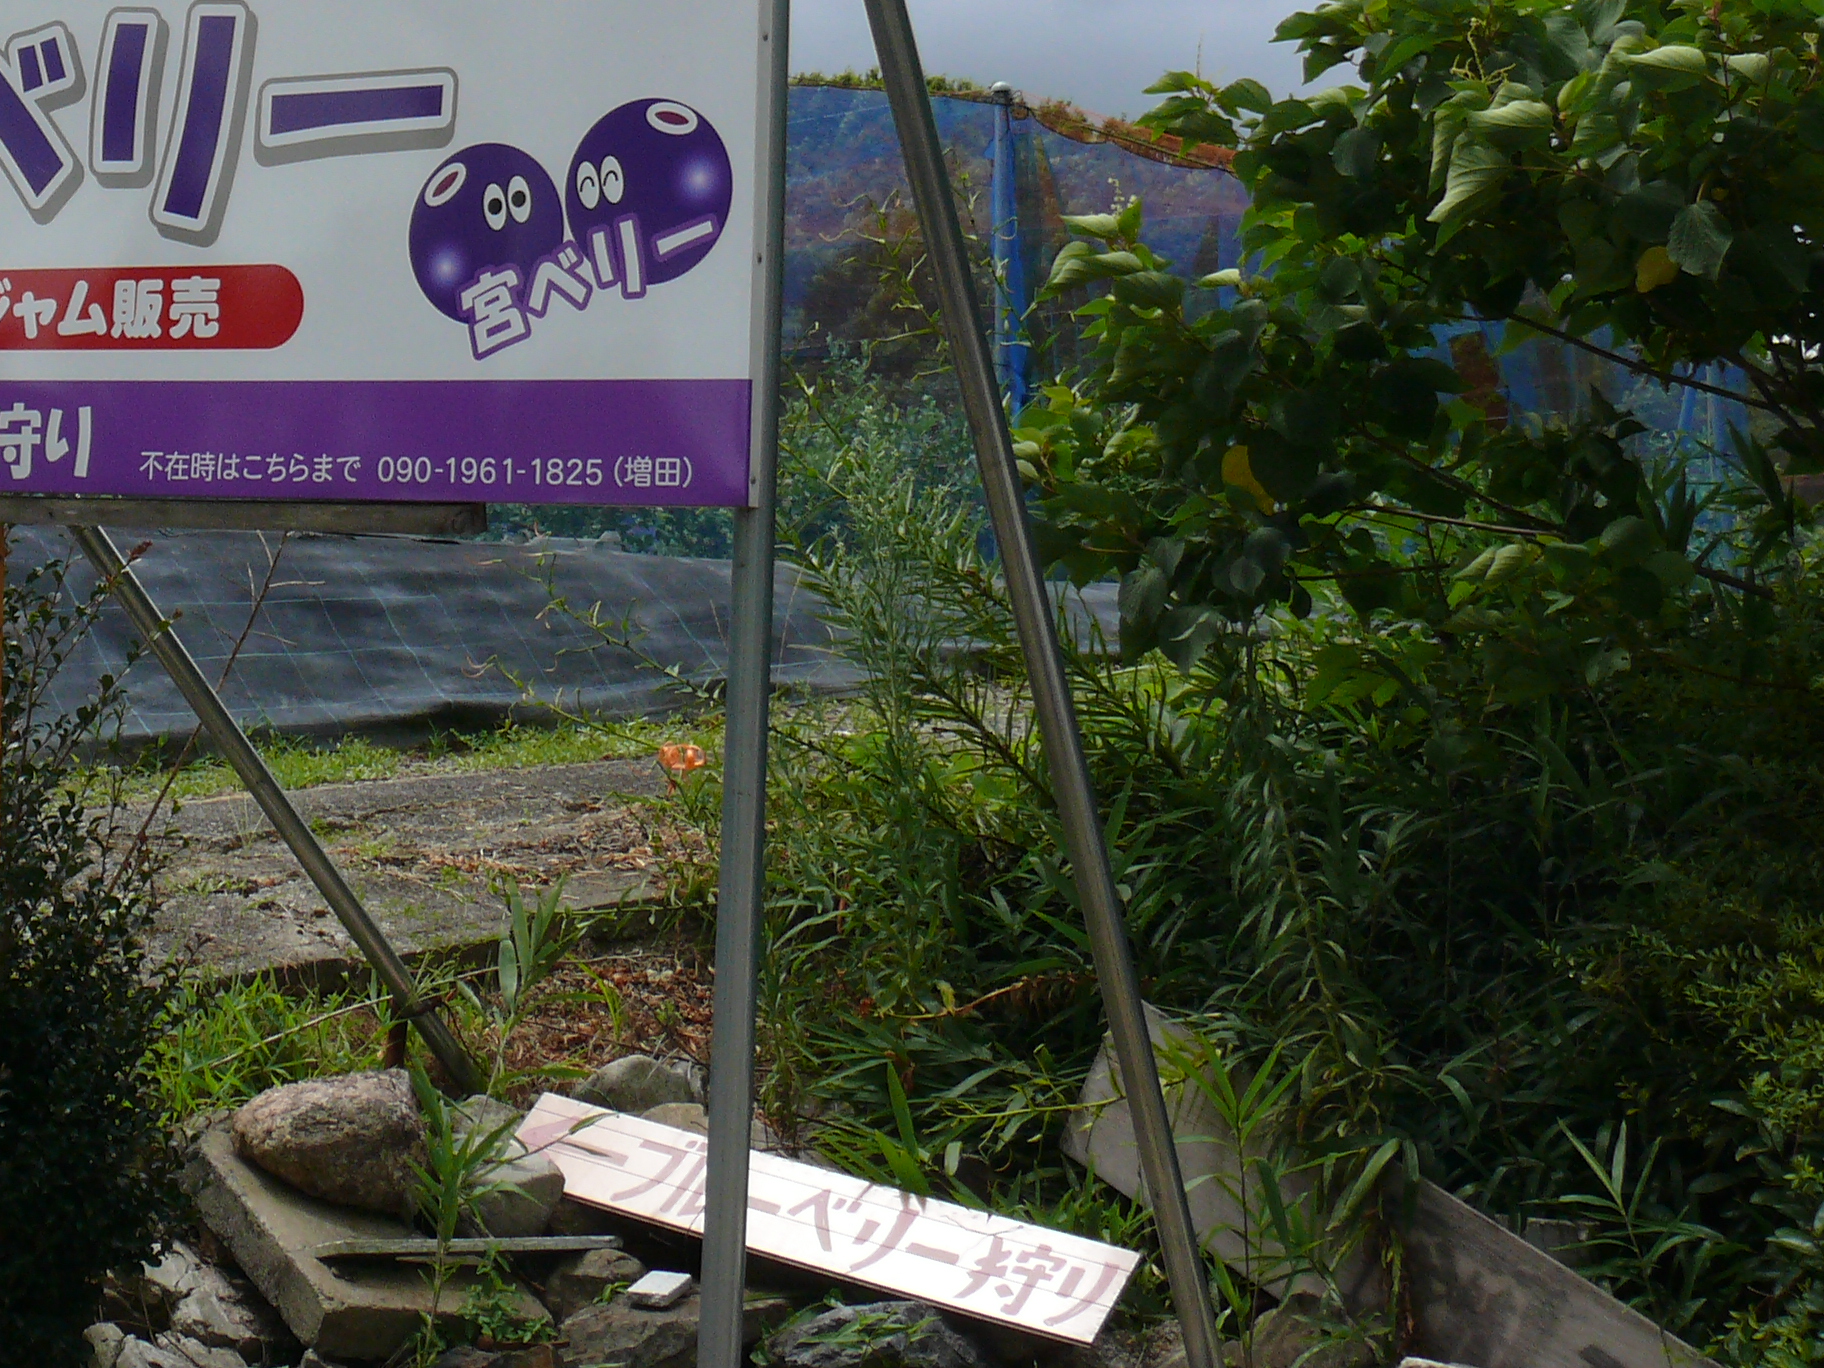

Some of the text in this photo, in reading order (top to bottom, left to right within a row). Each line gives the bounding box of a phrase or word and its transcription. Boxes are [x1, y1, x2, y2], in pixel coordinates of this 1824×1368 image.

[458, 215, 717, 359] 宮ベリー
[138, 450, 362, 483] 不在時はこちらまで
[376, 455, 603, 487] 090-1961-1825
